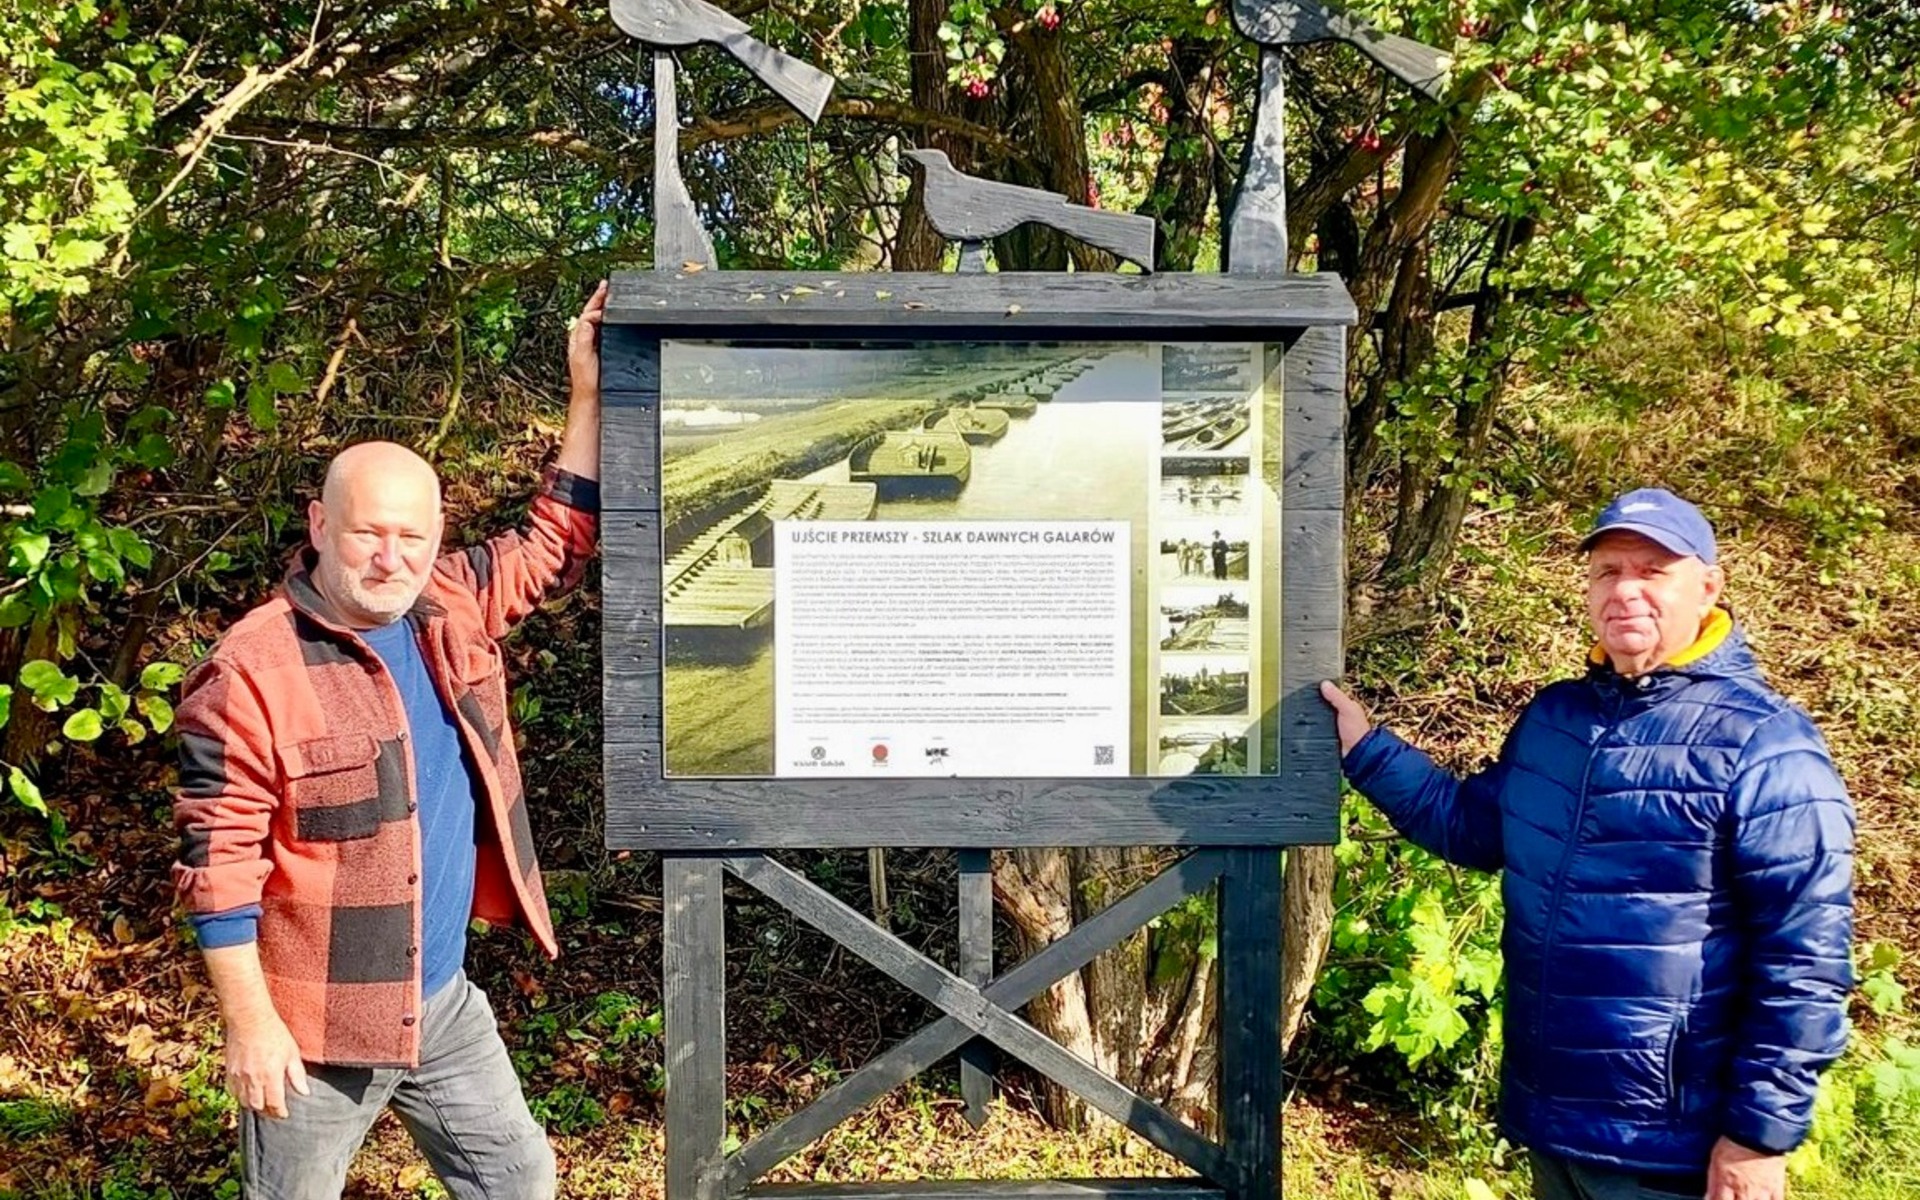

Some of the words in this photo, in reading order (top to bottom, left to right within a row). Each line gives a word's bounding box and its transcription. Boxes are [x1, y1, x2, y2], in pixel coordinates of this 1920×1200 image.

[792, 528, 838, 544] UJŚCIE
[842, 531, 909, 544] PRZEMSZY
[922, 531, 962, 544] SZLAK
[967, 531, 1040, 544] DAWNYCH
[1043, 528, 1115, 544] GALARÓW
